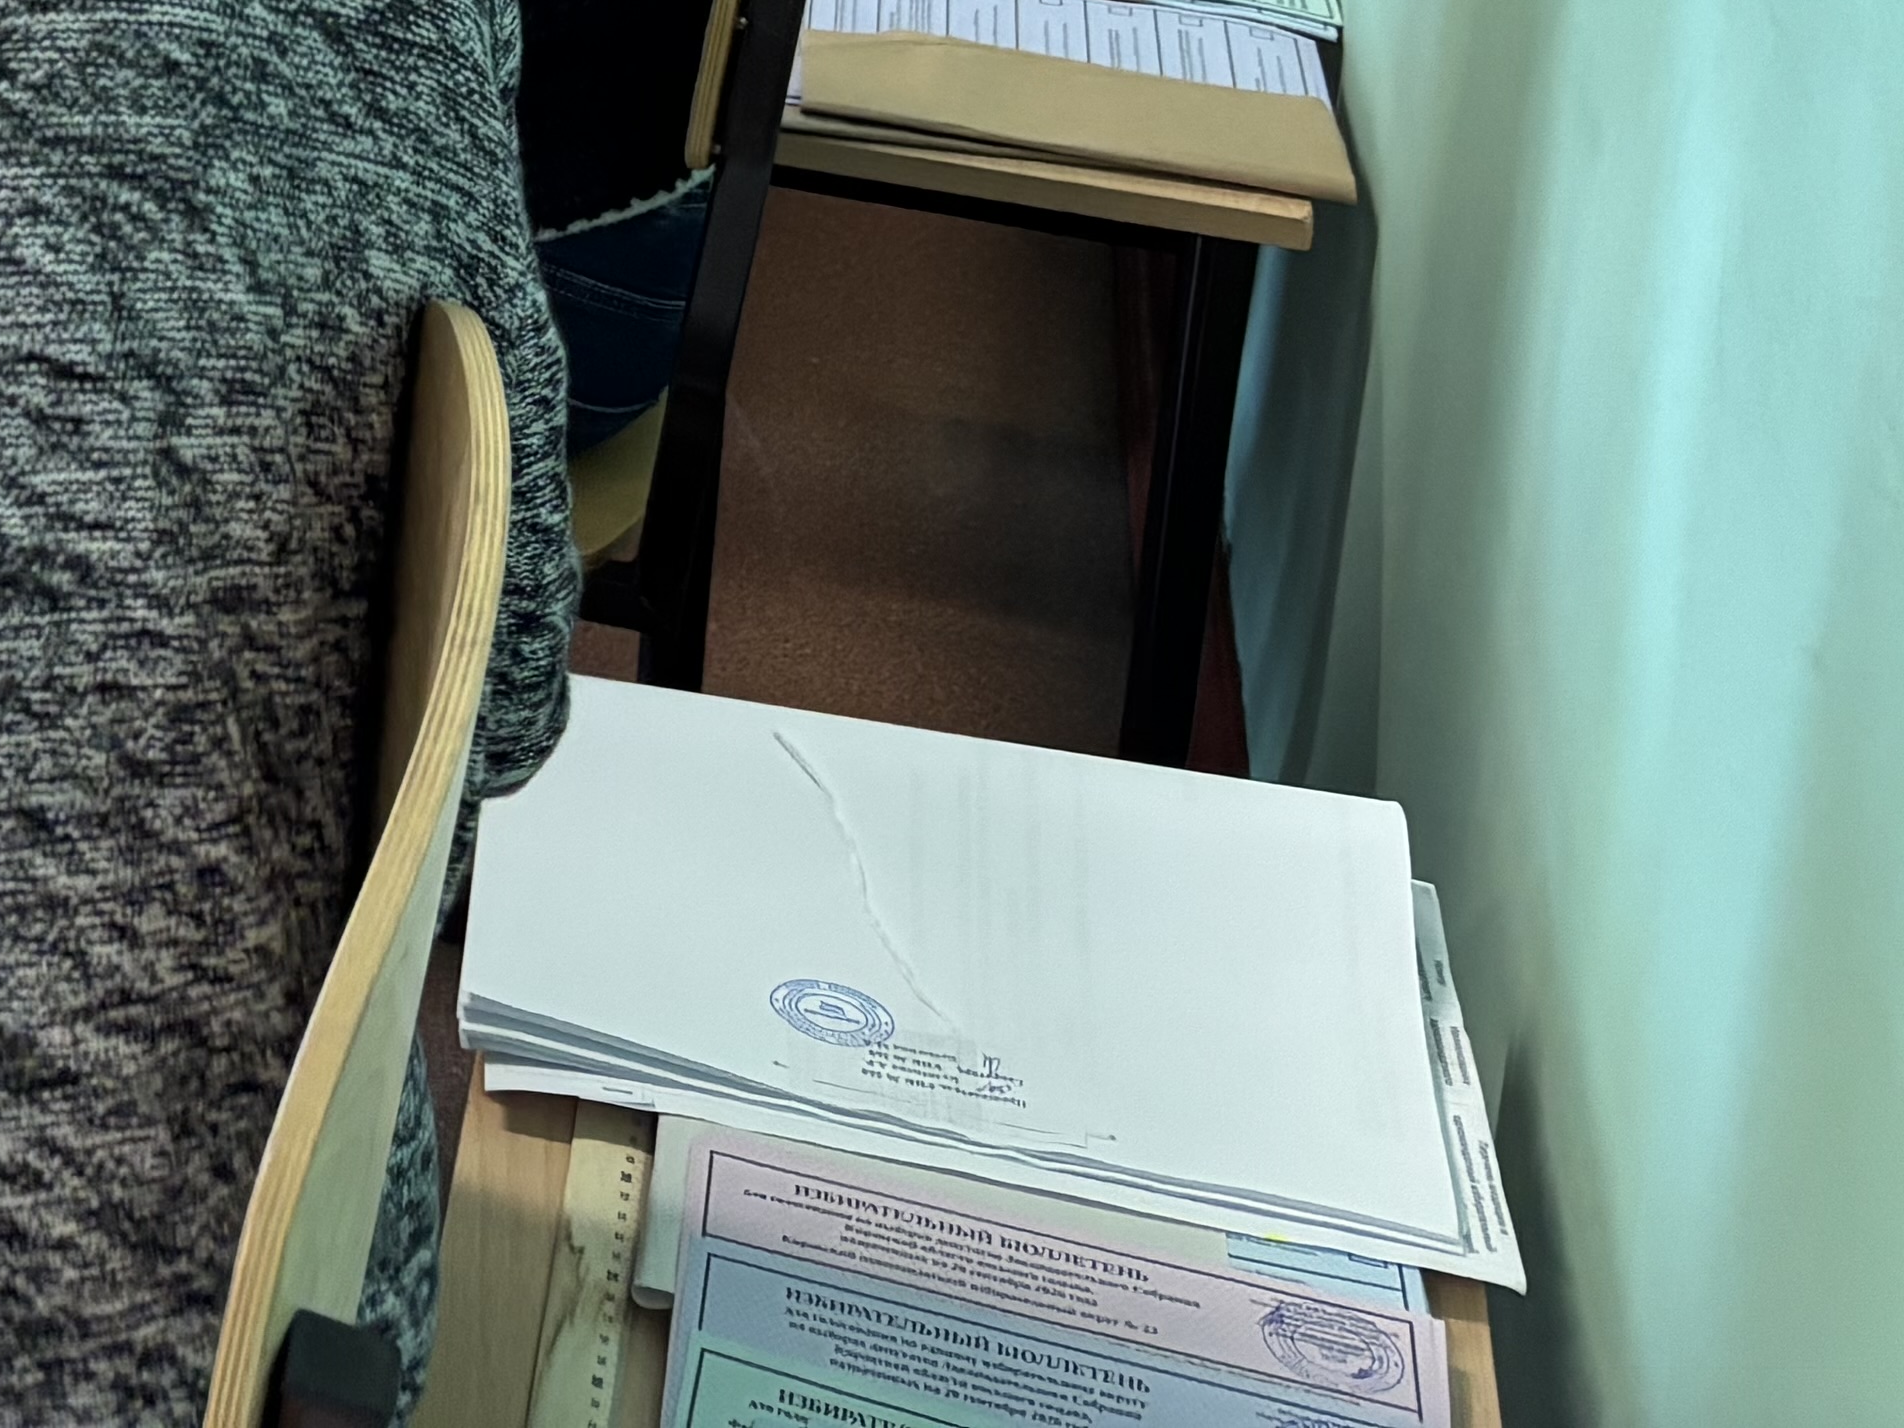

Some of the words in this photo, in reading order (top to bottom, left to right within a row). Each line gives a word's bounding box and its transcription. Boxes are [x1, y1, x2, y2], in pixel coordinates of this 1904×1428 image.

[793, 1184, 992, 1245] ИЗБИРАТЕЛЬНЫЙ
[999, 1234, 1149, 1282] БЮЛЛЕТЕНЬ
[785, 1286, 990, 1352] ИЗБИРАТЕЛЬНЫЙ
[997, 1341, 1150, 1394] БЮЛЛЕТЕНЬ
